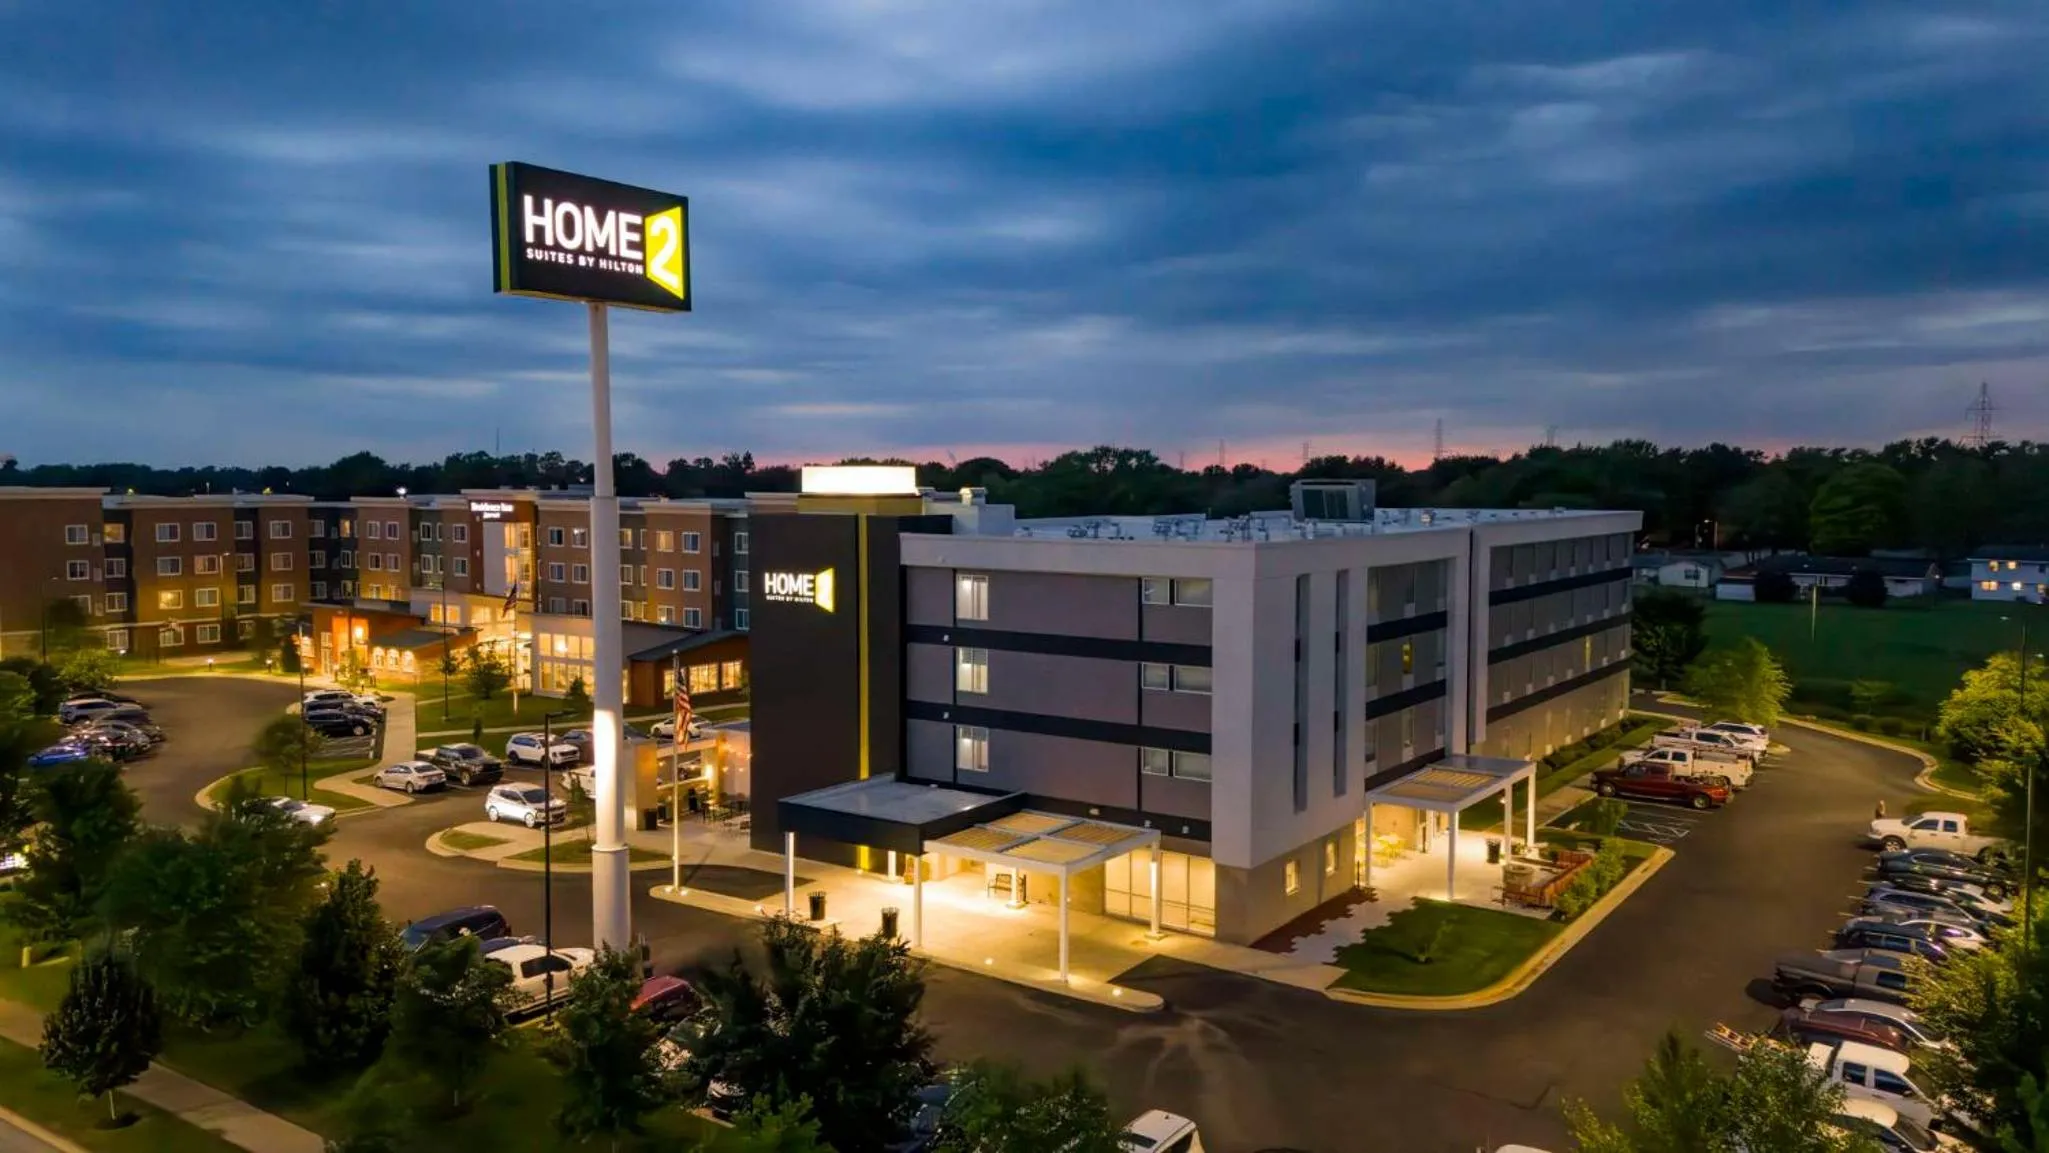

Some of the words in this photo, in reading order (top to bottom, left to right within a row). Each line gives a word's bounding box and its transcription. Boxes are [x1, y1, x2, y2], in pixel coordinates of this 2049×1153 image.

[523, 194, 643, 260] HOME
[650, 215, 680, 289] 2
[526, 248, 574, 264] SUITES
[578, 255, 595, 267] BY
[599, 258, 643, 274] HILTON
[764, 572, 815, 596] HOME
